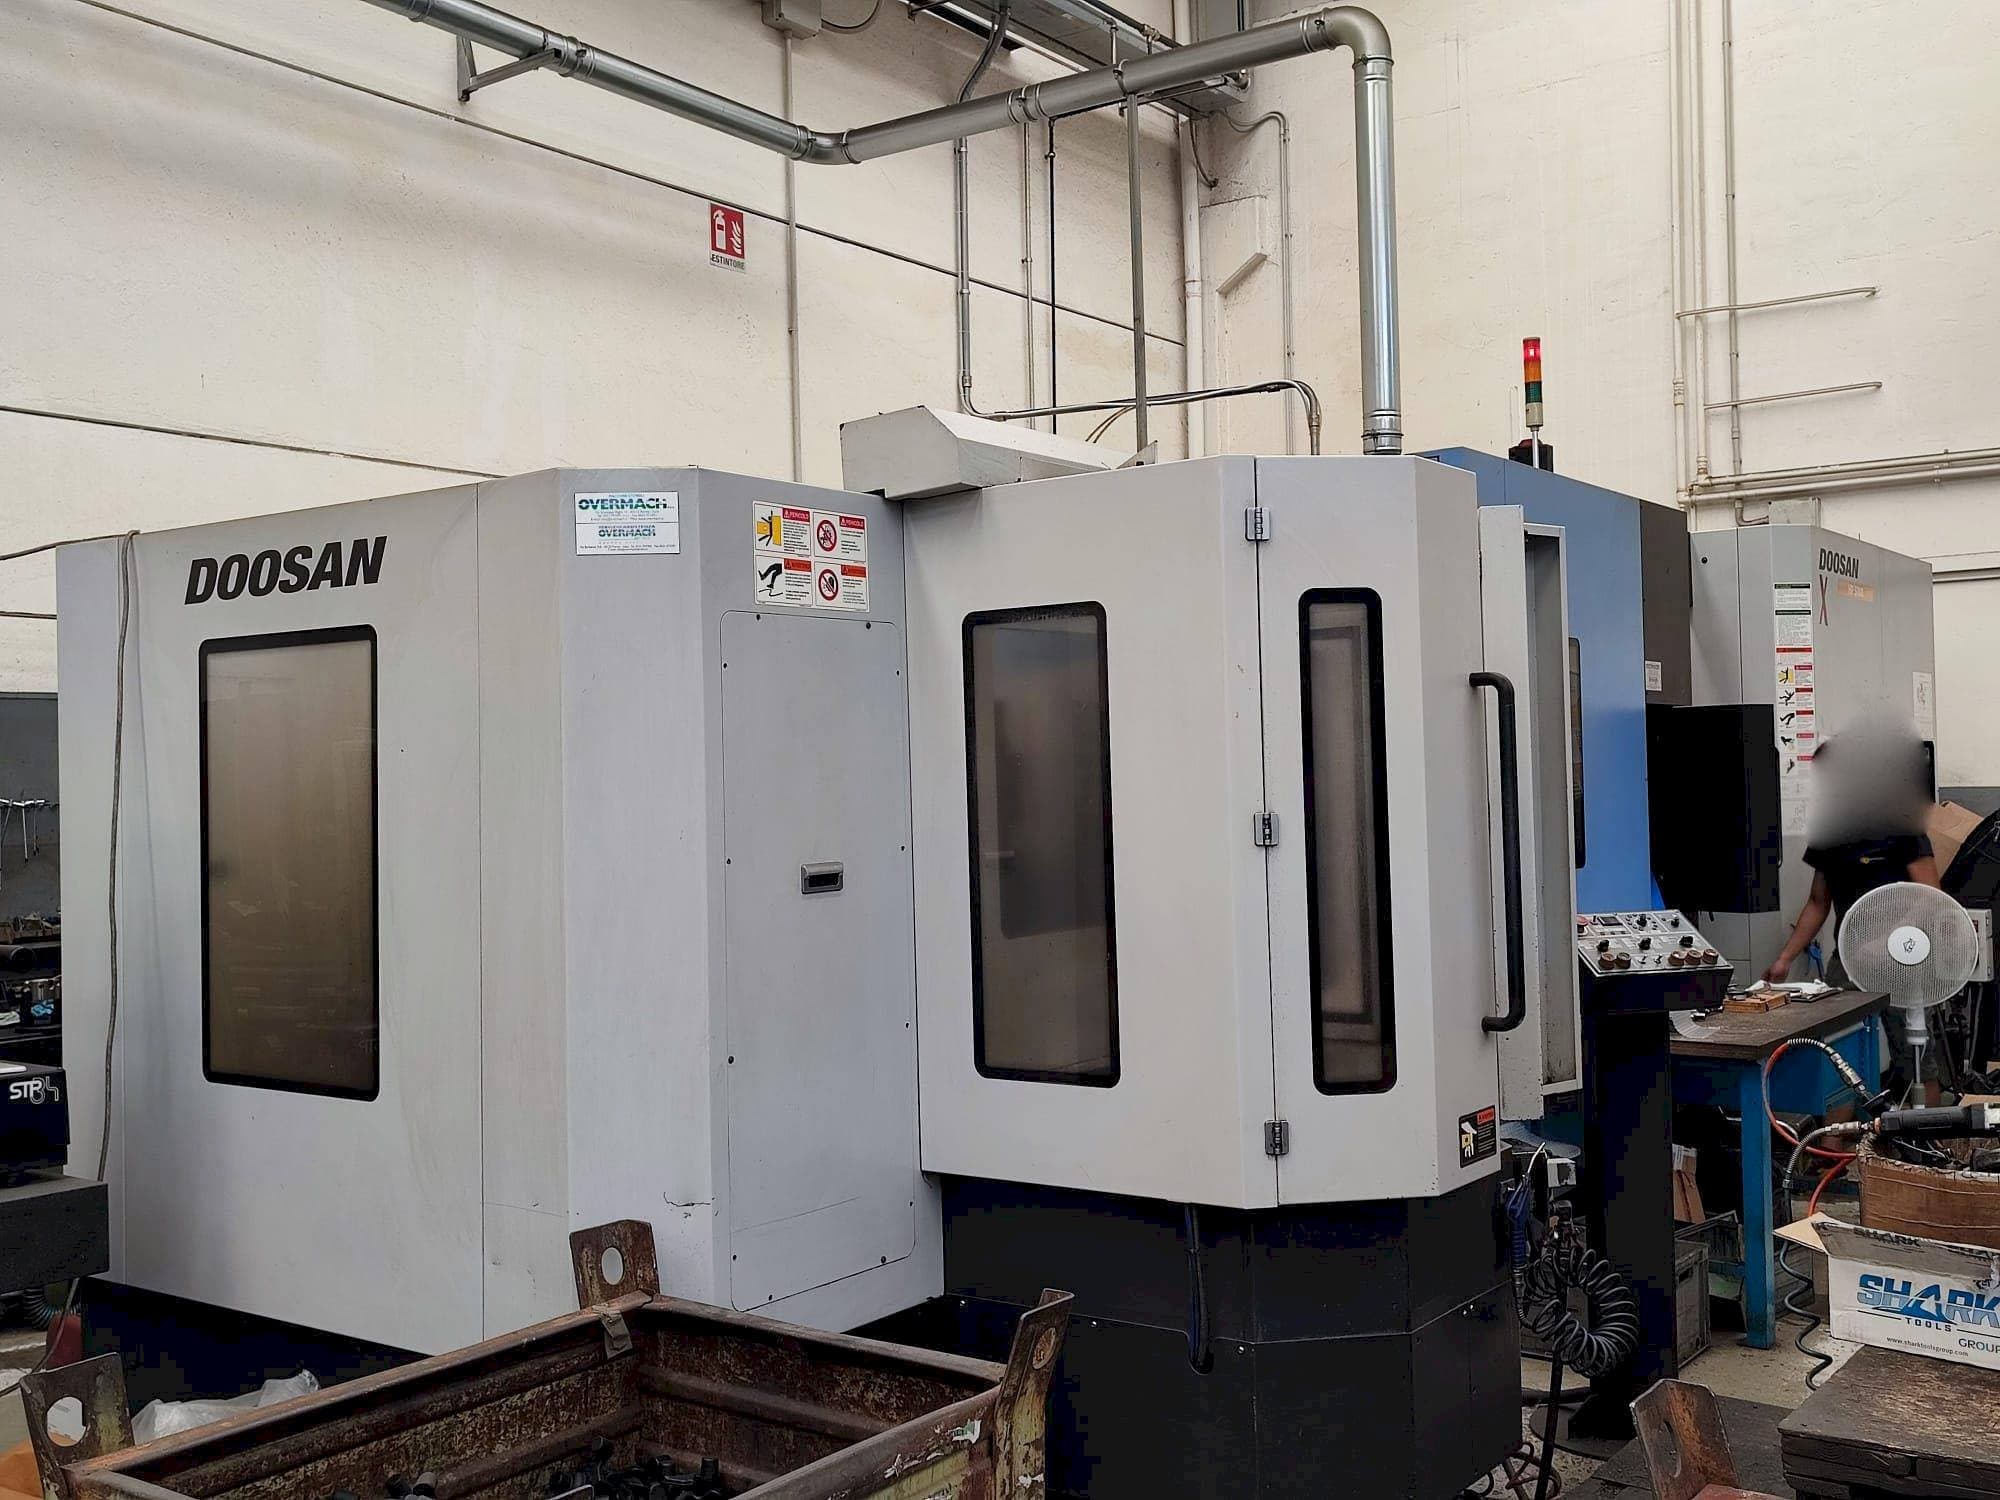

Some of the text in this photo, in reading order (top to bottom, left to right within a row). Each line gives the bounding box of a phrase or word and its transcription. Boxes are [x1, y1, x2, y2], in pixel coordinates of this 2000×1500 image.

[711, 253, 745, 270] ESTINTORE
[578, 498, 667, 510] OVERMACH
[598, 529, 656, 537] OVERMACH
[184, 536, 387, 605] DOOSAN
[1819, 548, 1859, 579] DOOSAN
[1857, 1273, 2000, 1328] SHARK
[1904, 1317, 1952, 1332] TOOLS
[1886, 1336, 1969, 1357] www.sharktoolsgroup.com
